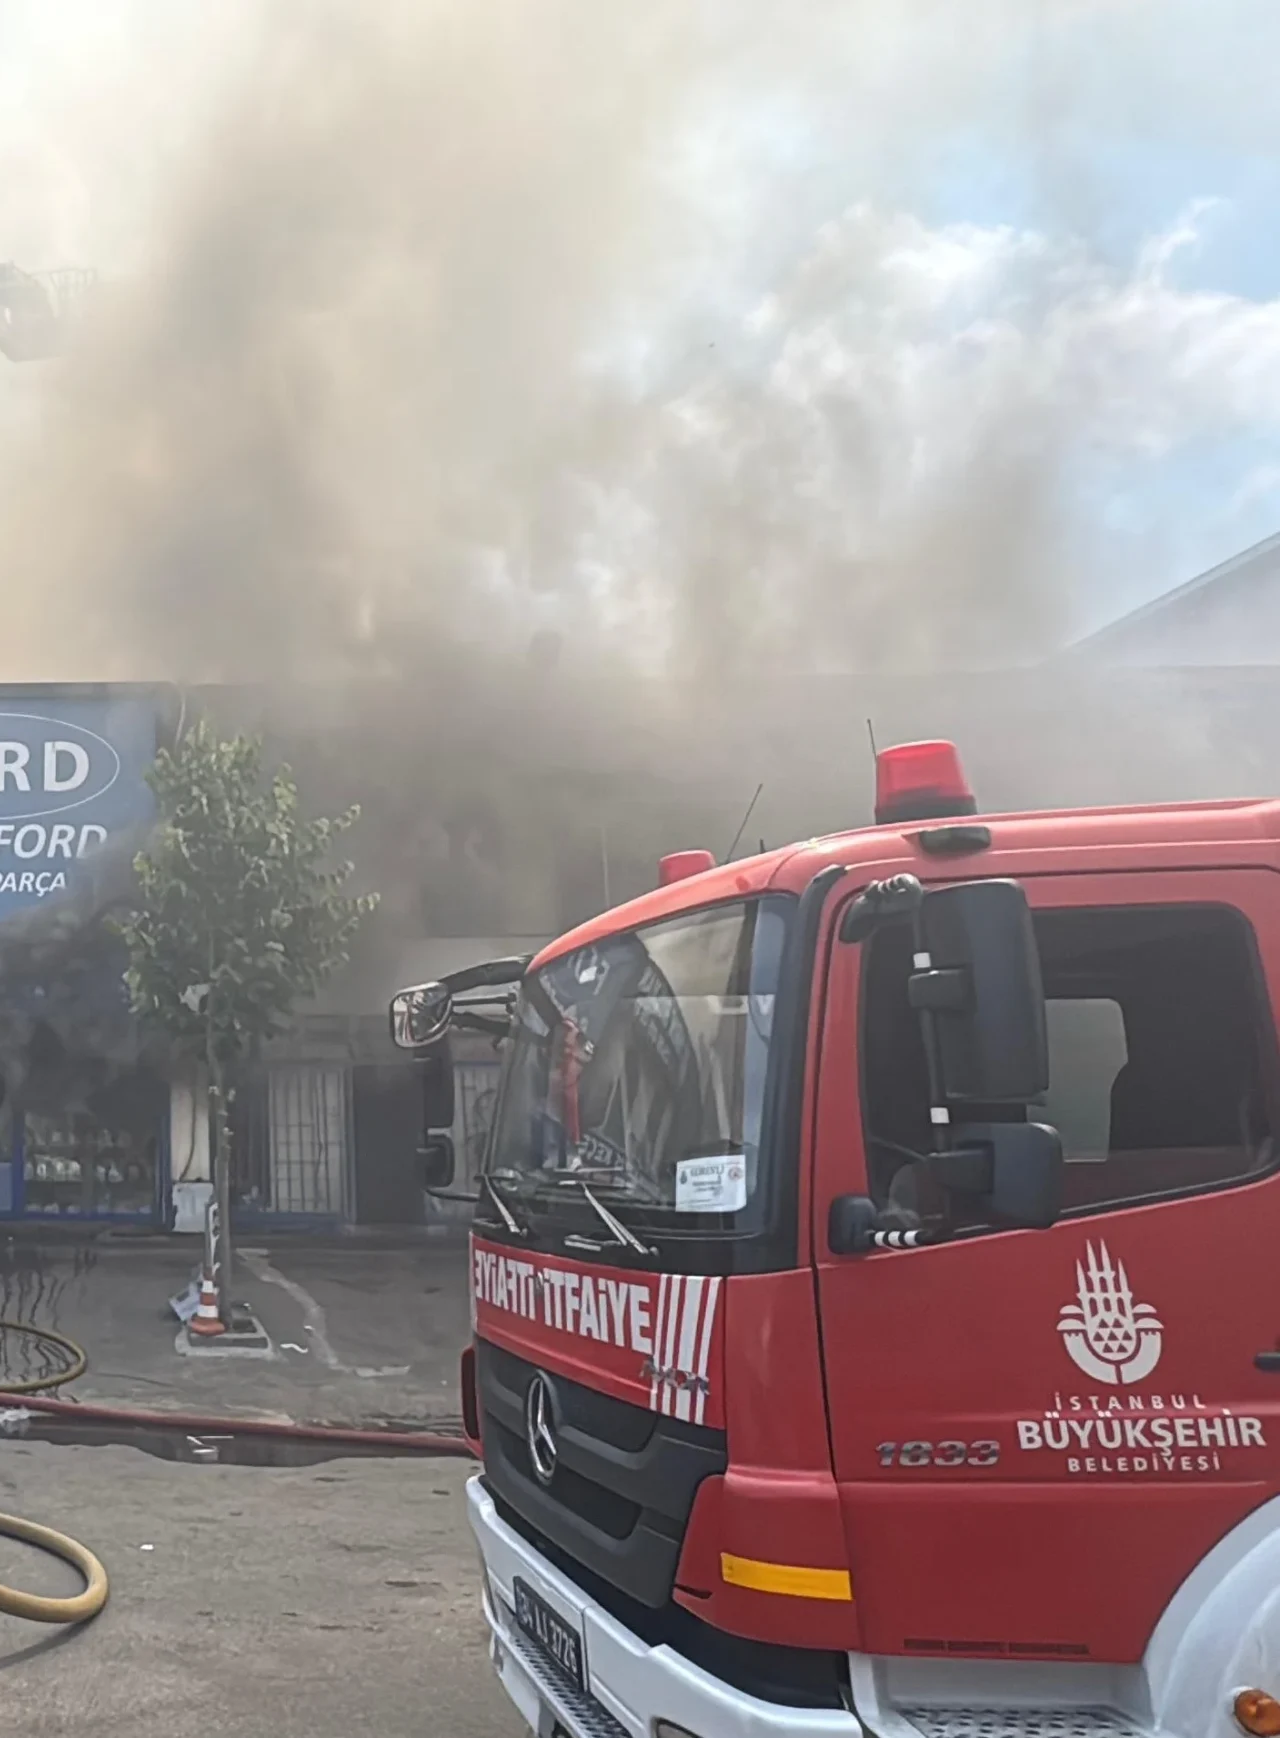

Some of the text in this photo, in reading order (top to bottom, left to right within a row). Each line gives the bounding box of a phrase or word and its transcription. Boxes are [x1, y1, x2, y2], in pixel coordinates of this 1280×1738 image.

[542, 1267, 654, 1355] İTFAİYE
[1054, 1391, 1207, 1412] İSTANBUL
[1017, 1408, 1267, 1456] BÜYÜKŞEHİR
[875, 1440, 1001, 1466] 1833
[1068, 1451, 1220, 1472] BELEDİYESİ
